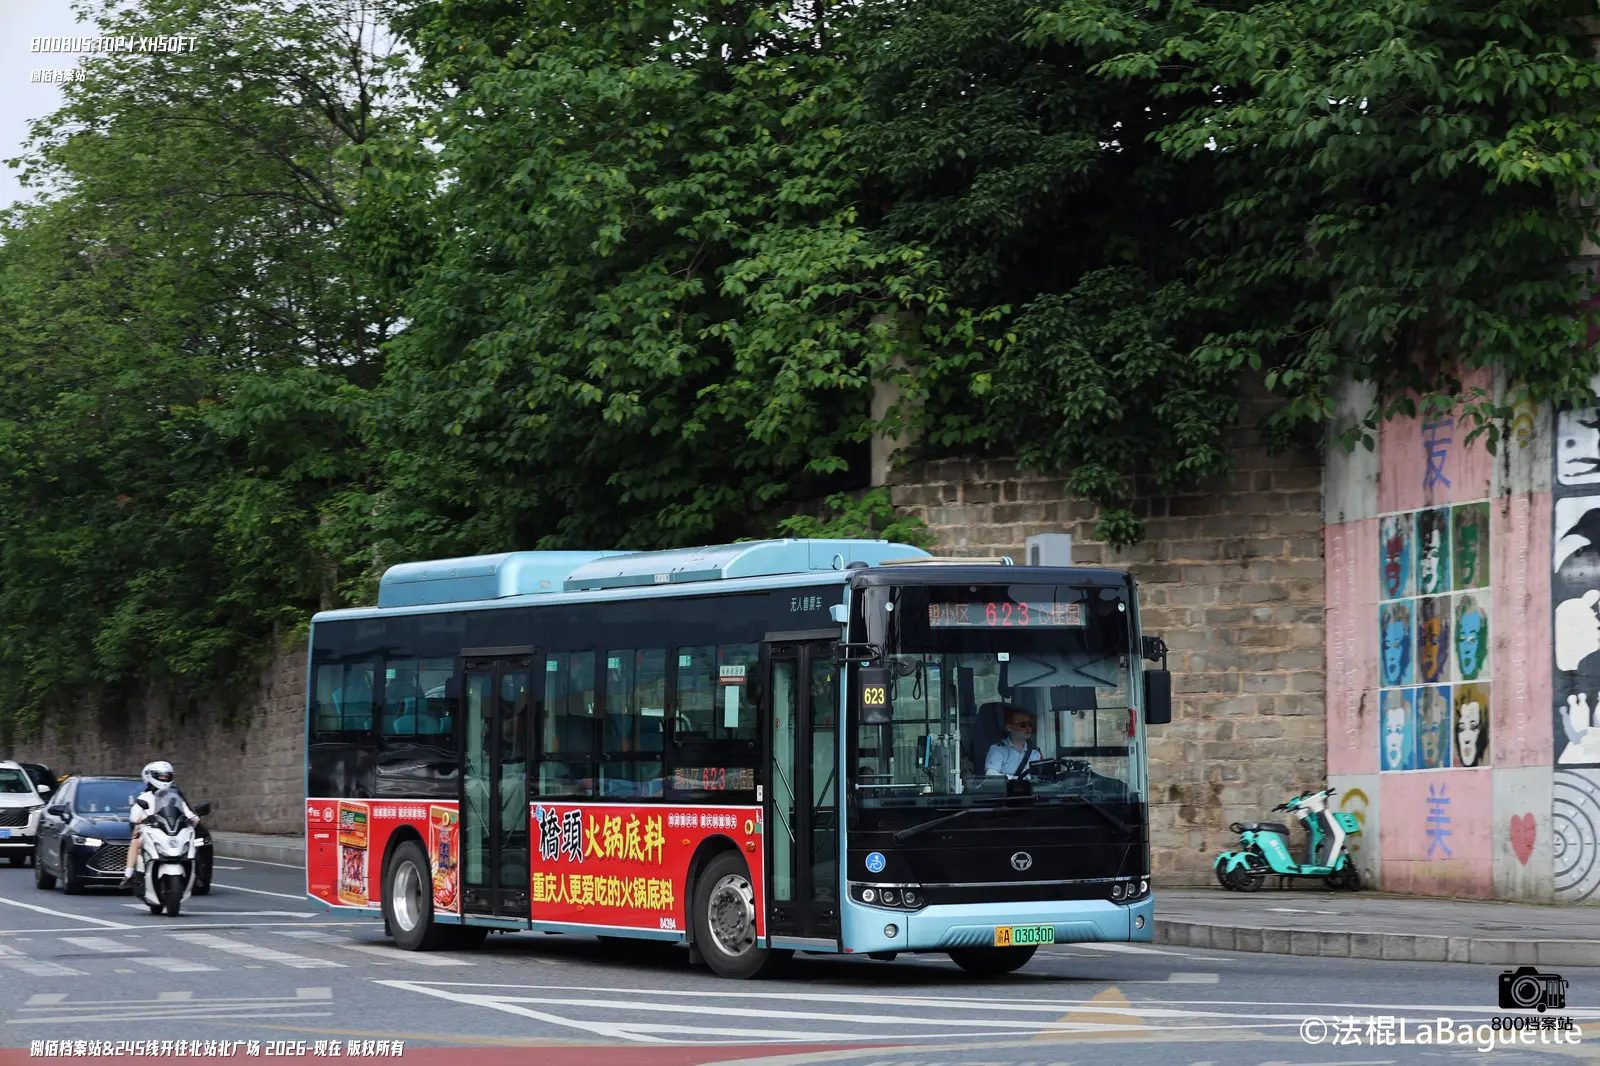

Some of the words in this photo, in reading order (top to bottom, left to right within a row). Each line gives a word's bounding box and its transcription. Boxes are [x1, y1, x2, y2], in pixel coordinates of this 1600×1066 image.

[789, 595, 823, 612] 无人售票车
[985, 602, 1030, 626] 623
[863, 687, 886, 706] 623
[702, 767, 726, 791] 623
[1425, 781, 1453, 858] 美
[532, 871, 675, 911] 重庆人更爱吃的火锅底料
[659, 916, 677, 930] 84394
